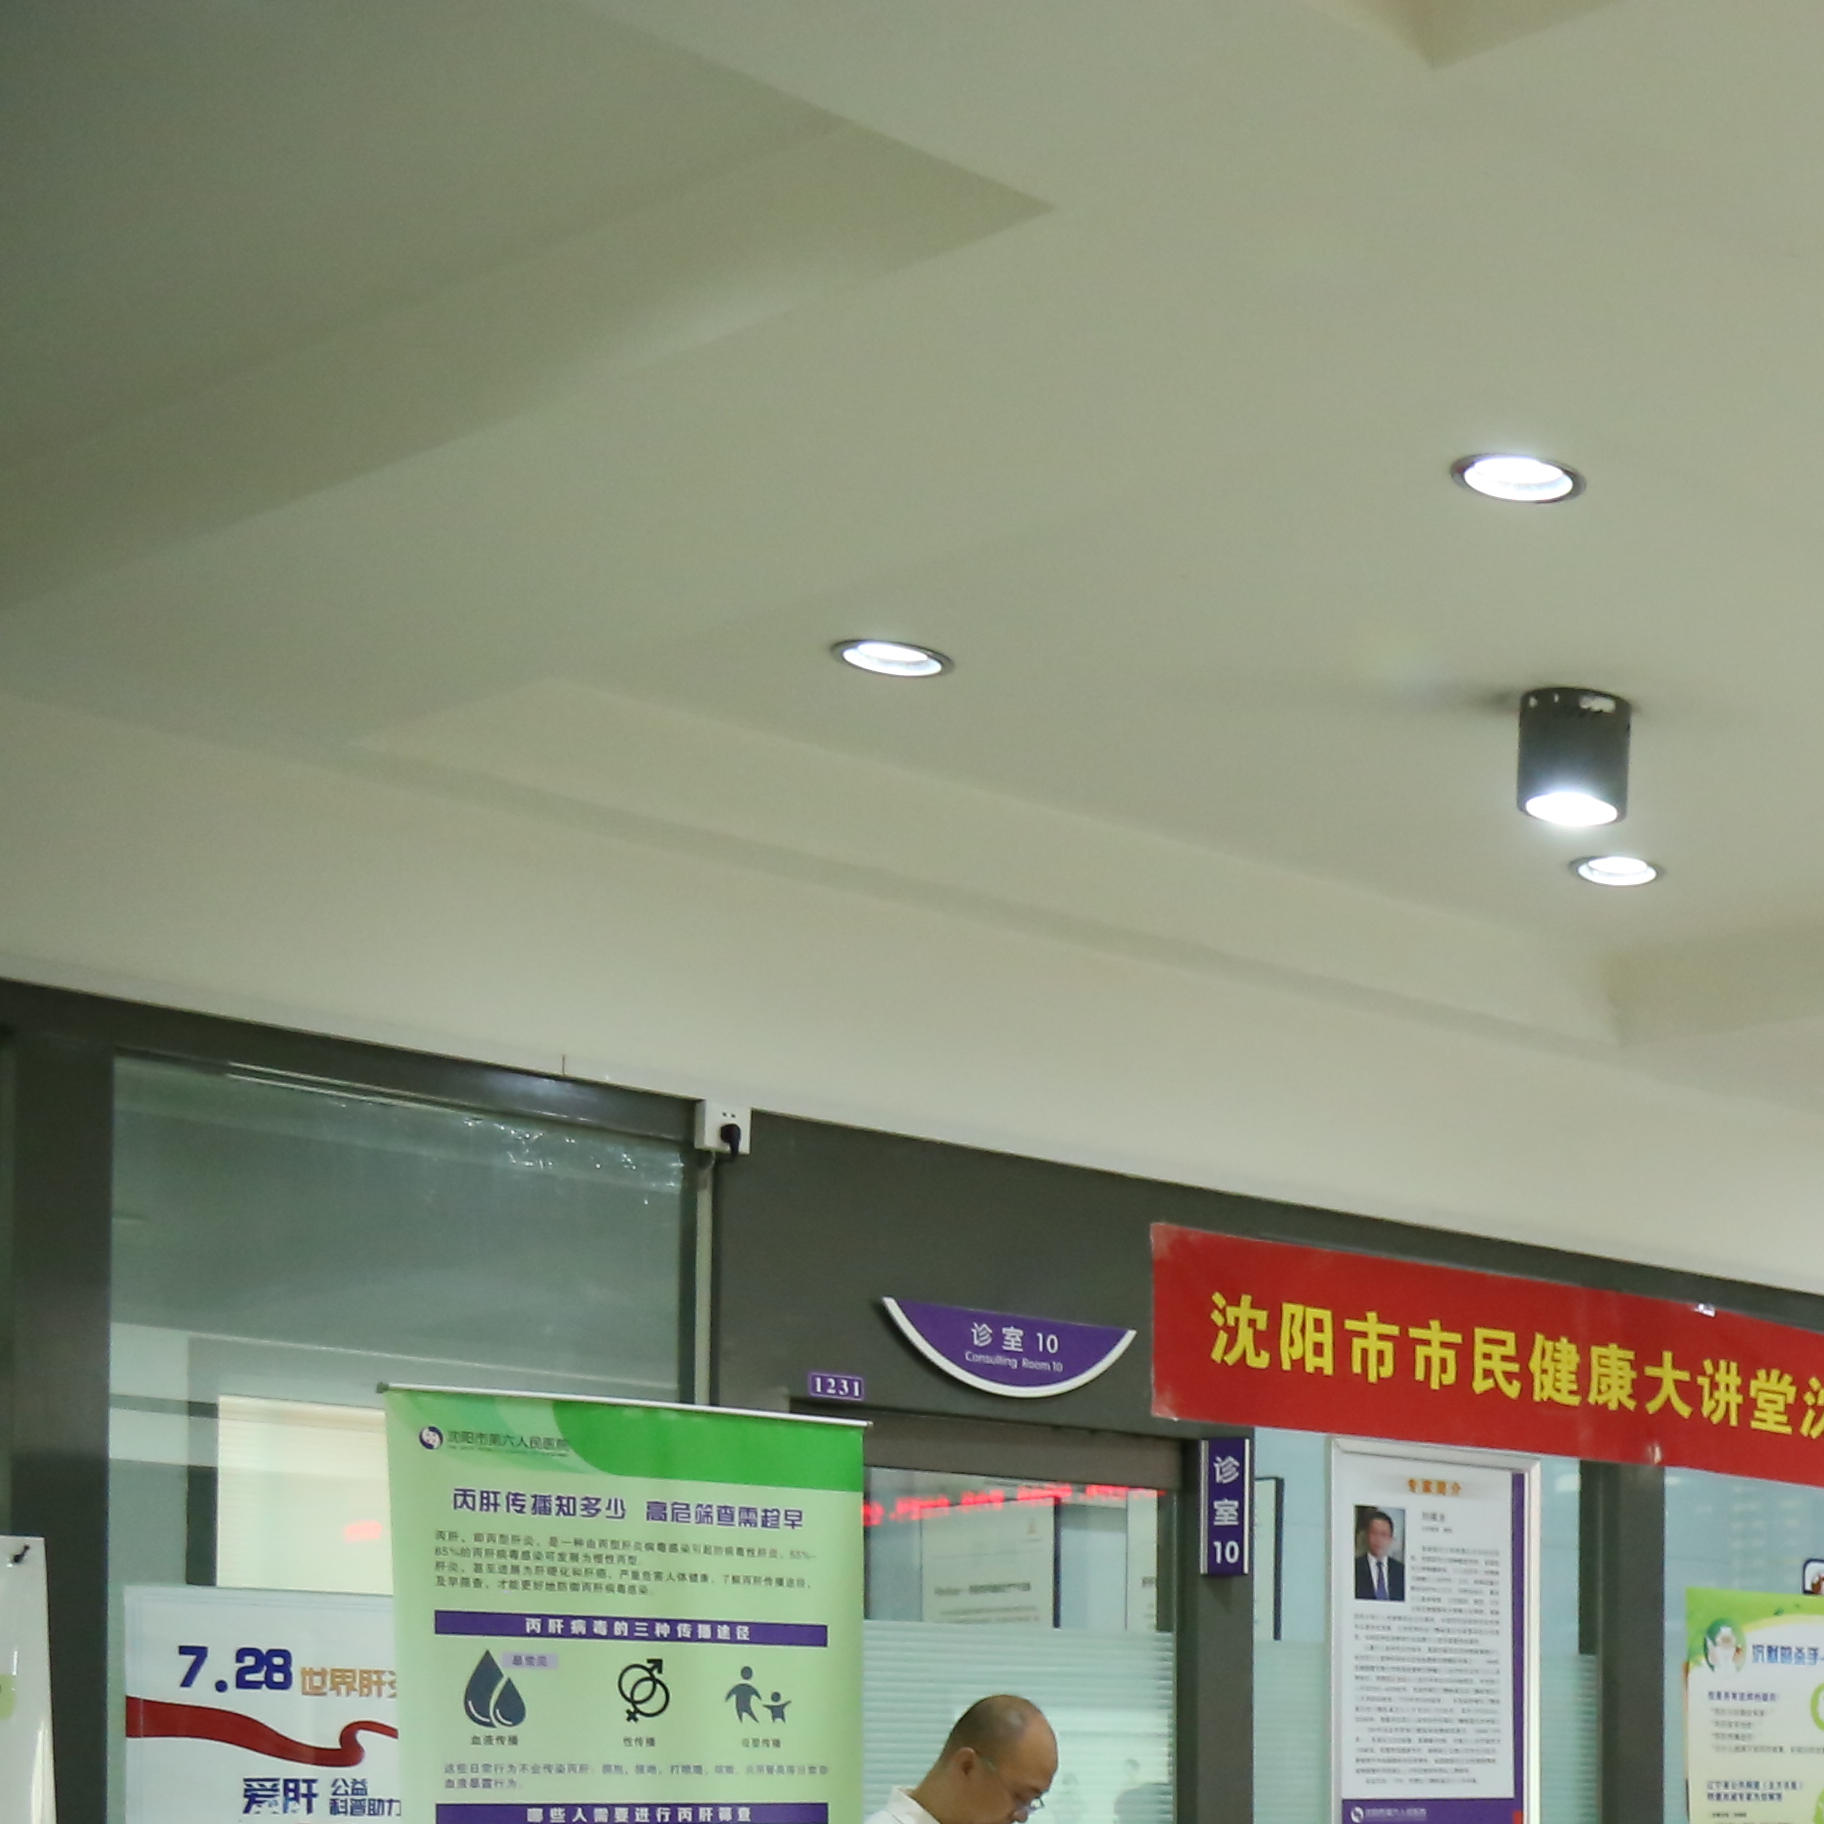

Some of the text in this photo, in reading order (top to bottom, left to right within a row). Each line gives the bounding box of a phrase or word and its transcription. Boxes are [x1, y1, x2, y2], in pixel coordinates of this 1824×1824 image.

[970, 1321, 1060, 1354] 诊室 10
[964, 1350, 1064, 1373] Consulting Room 10
[814, 1376, 861, 1397] 1231
[452, 1487, 804, 1530] 丙肝传播知多少 高危筛查需趁早
[525, 1616, 751, 1642] 丙肝病毒的三种传播途径
[178, 1645, 294, 1693] 7.28
[470, 1734, 520, 1747] 血液传播
[622, 1737, 657, 1748] 性传播
[242, 1777, 369, 1816] 爱肝 公益
[526, 1805, 752, 1824] 哪些人需要进行丙肝筛查
